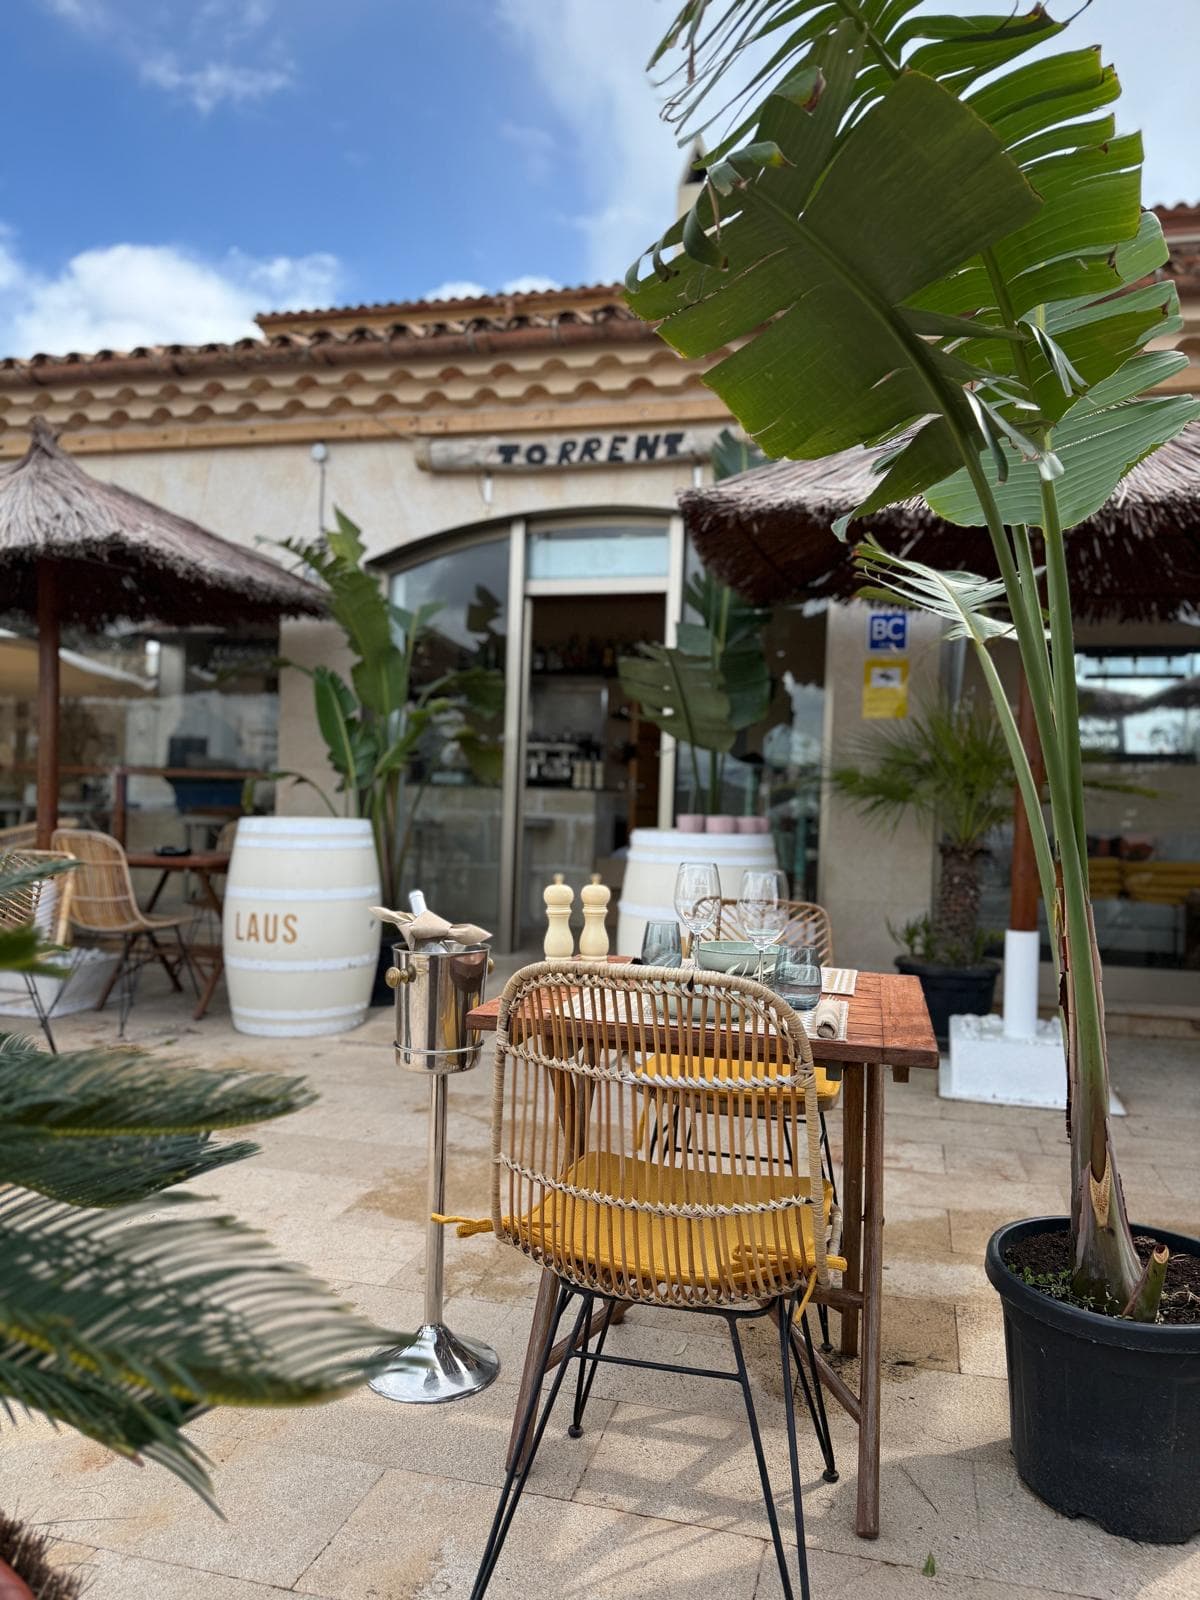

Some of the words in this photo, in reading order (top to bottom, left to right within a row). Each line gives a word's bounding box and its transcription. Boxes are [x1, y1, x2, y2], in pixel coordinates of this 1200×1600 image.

[497, 433, 686, 465] TORRENT
[871, 617, 905, 640] BC
[235, 912, 298, 944] LAUS
